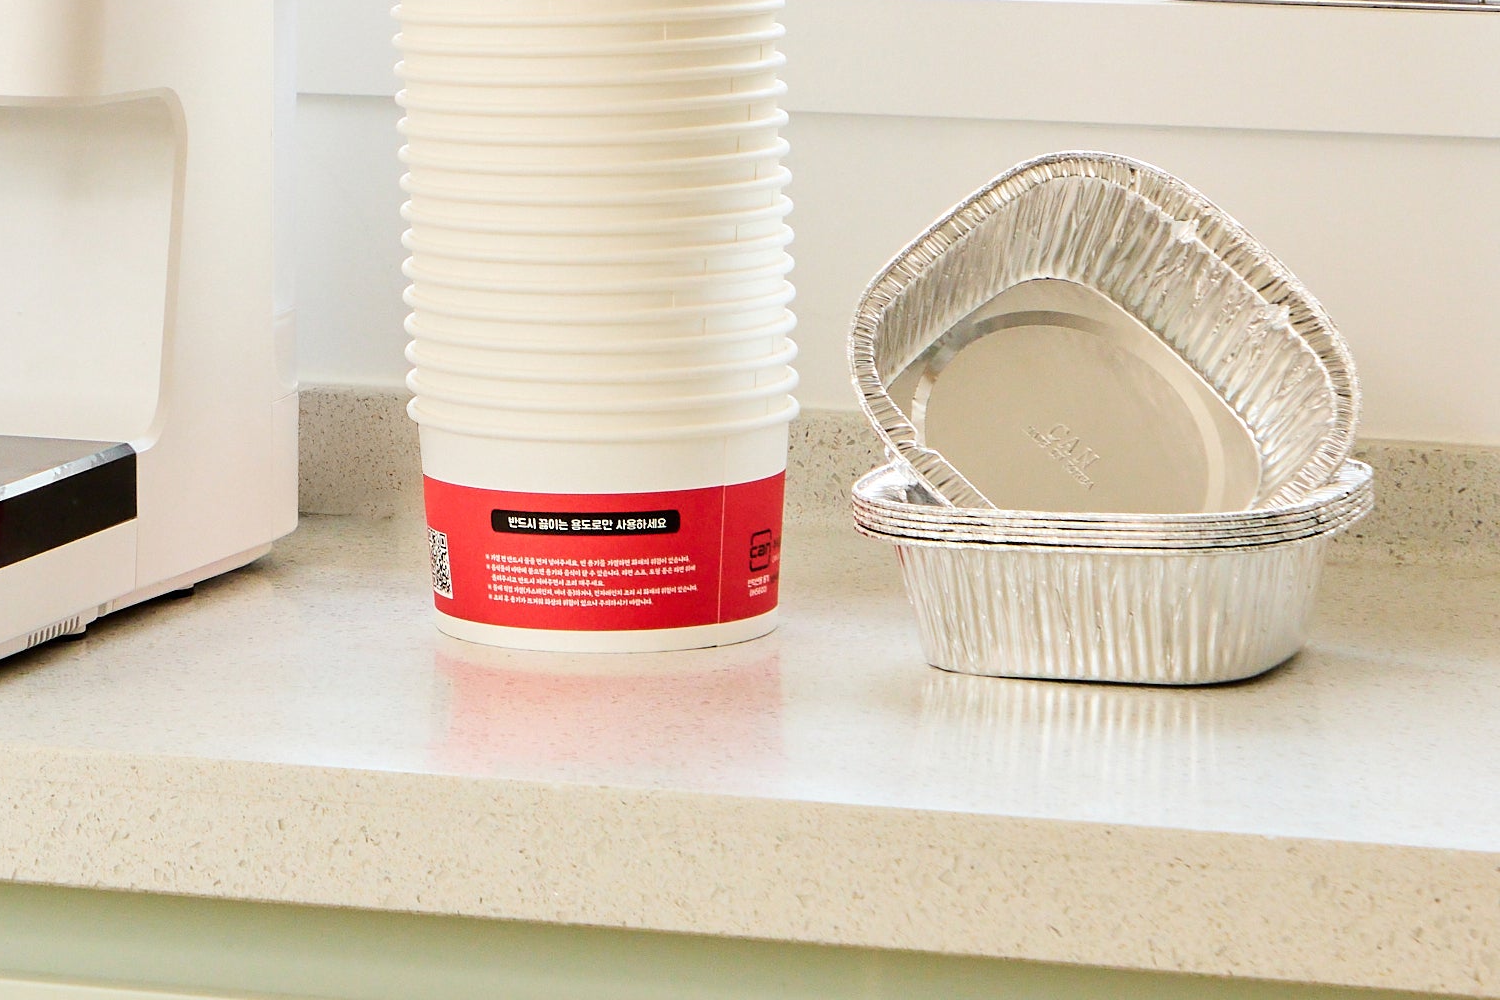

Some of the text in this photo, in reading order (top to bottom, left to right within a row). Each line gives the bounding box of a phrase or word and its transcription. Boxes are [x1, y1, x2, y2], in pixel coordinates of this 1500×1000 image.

[507, 516, 668, 532] 반드시 끓이는 용도로만 사용하세요
